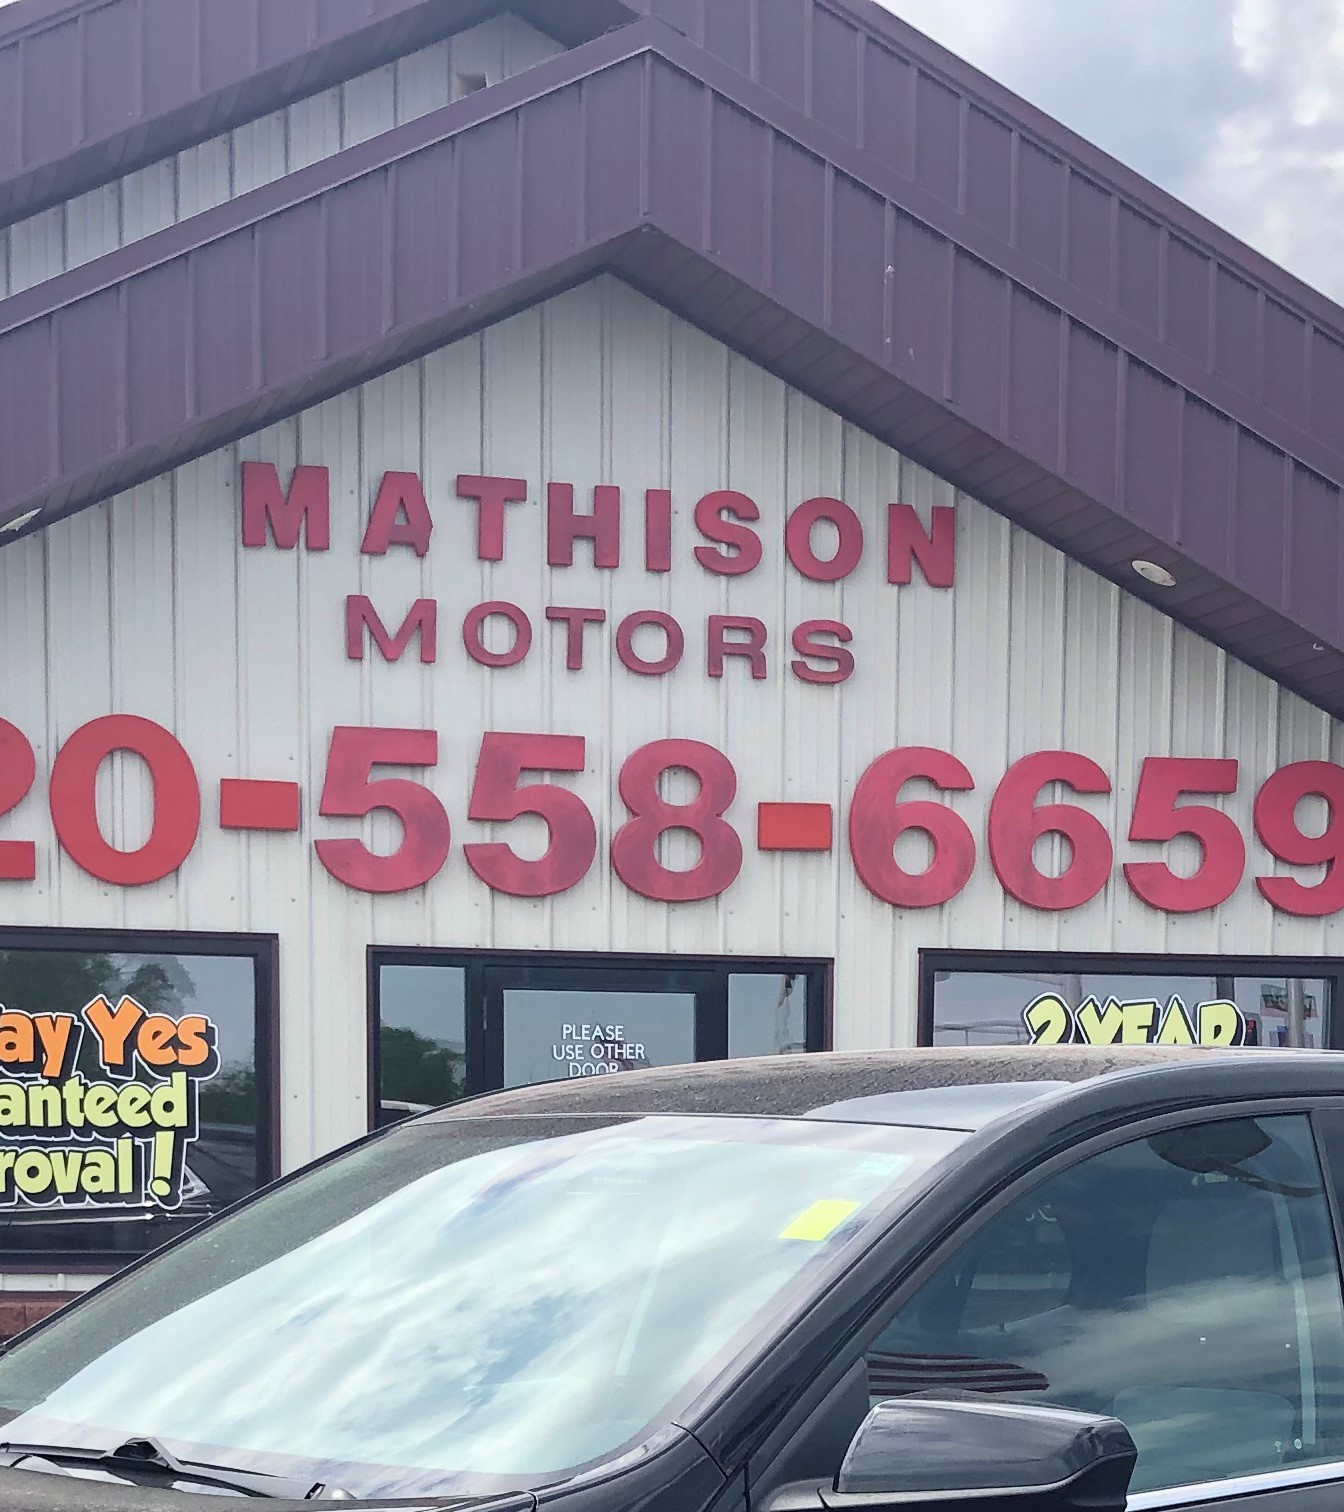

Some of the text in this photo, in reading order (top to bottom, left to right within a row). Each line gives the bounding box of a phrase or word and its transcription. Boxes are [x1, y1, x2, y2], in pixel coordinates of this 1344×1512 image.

[241, 461, 956, 588] MATHISON
[346, 594, 855, 684] MOTORS
[84, 994, 212, 1070] Yes
[562, 1023, 624, 1040] PLEASE
[1026, 995, 1071, 1044] 2
[552, 1043, 645, 1060] USE OTHER
